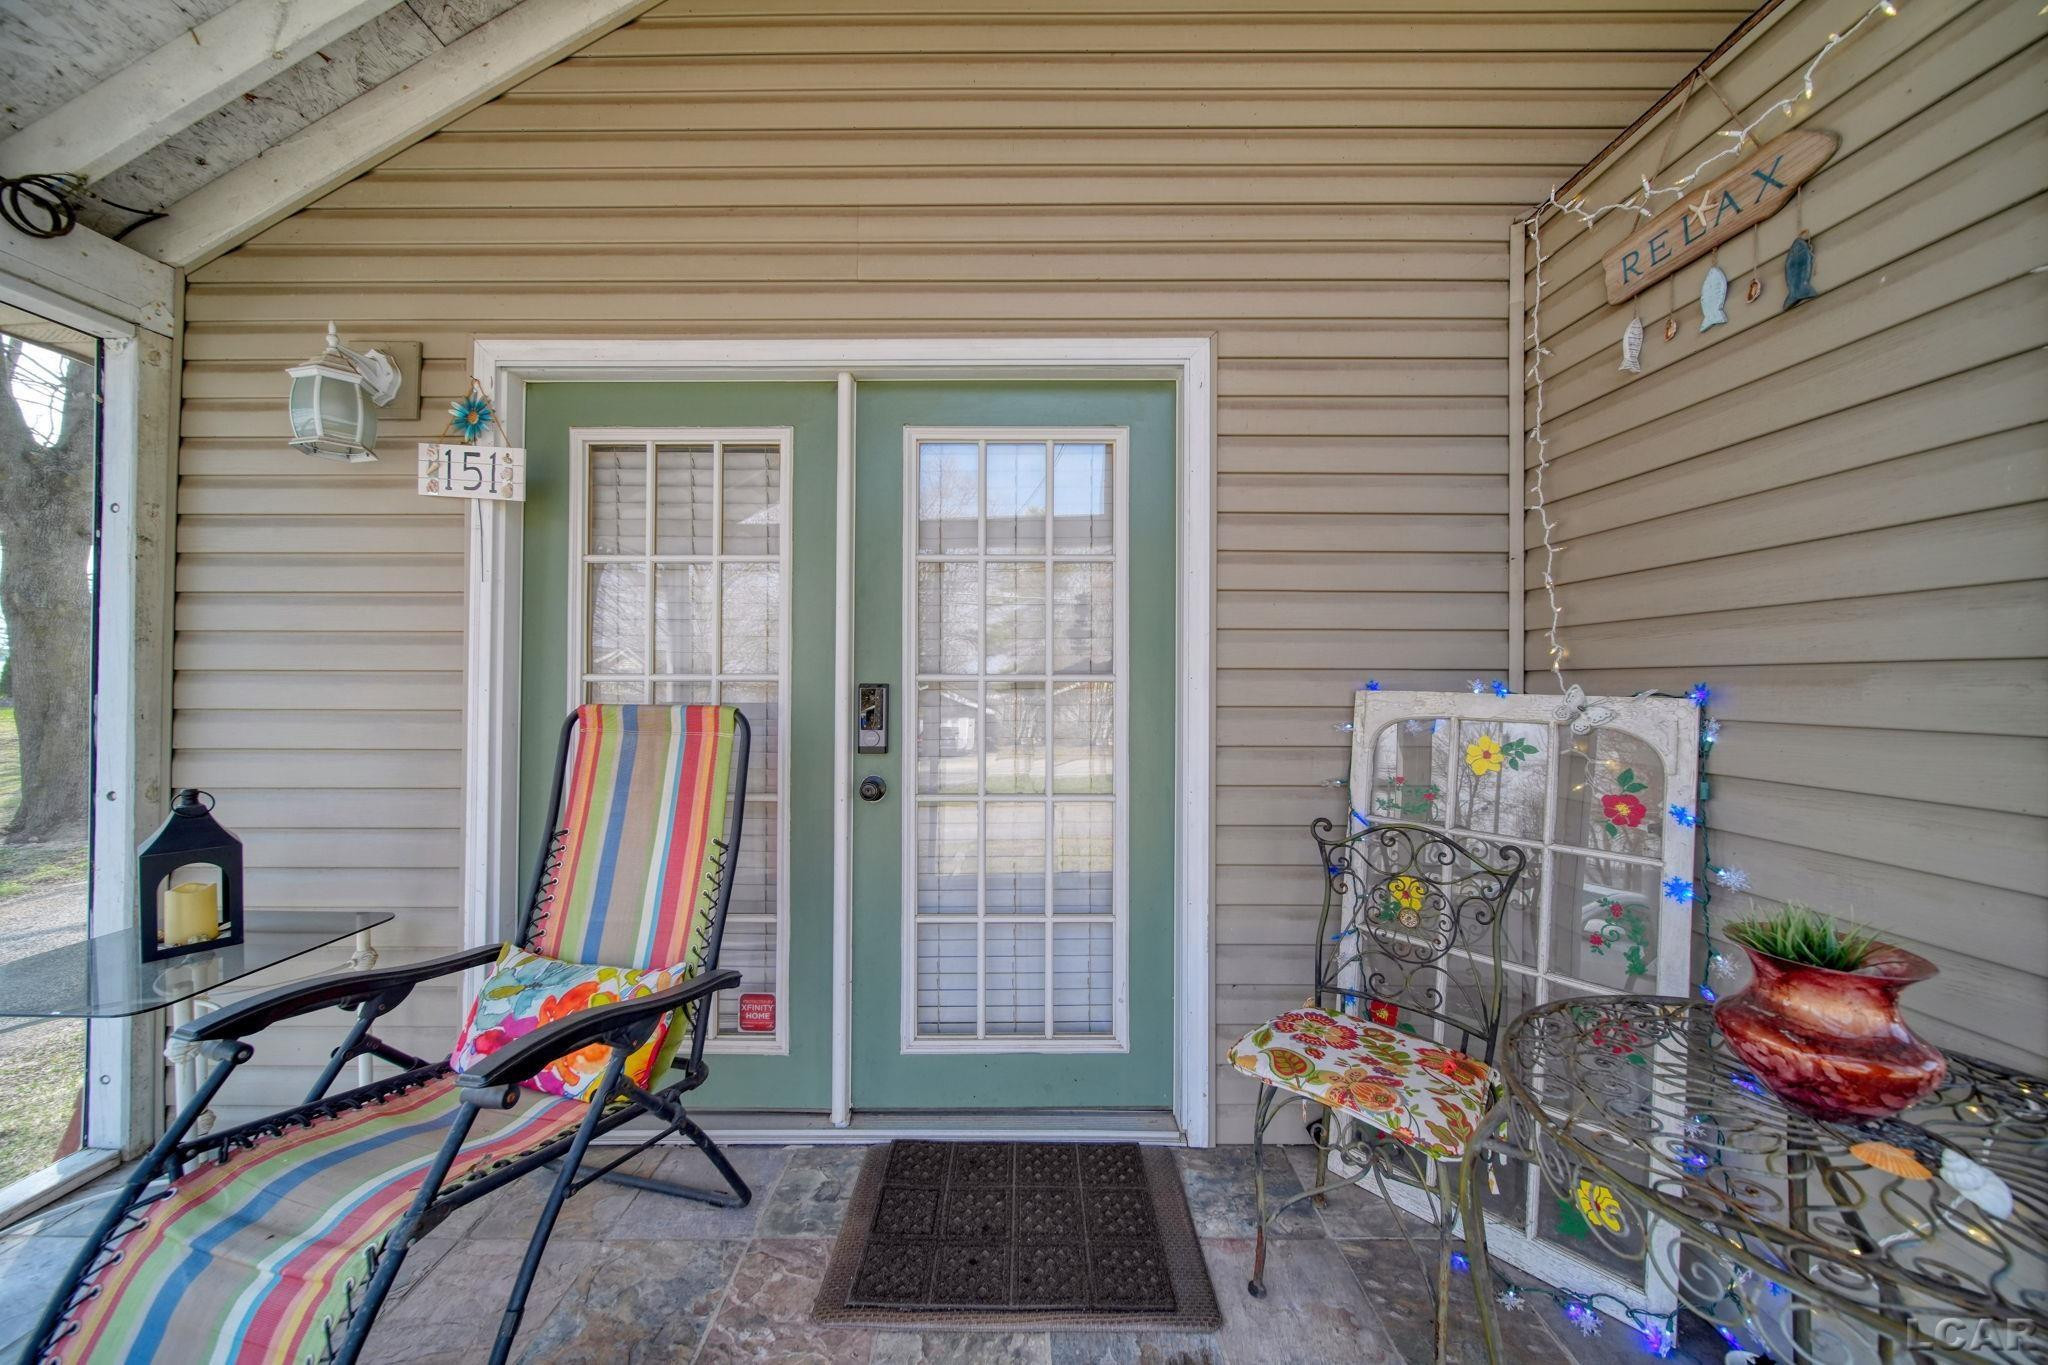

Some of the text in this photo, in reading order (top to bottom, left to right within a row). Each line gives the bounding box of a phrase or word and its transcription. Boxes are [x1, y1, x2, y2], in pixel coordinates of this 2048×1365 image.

[1620, 154, 1788, 286] RELAX
[444, 449, 498, 494] 151
[741, 1004, 774, 1012] XFINITY
[745, 1012, 771, 1020] HOME
